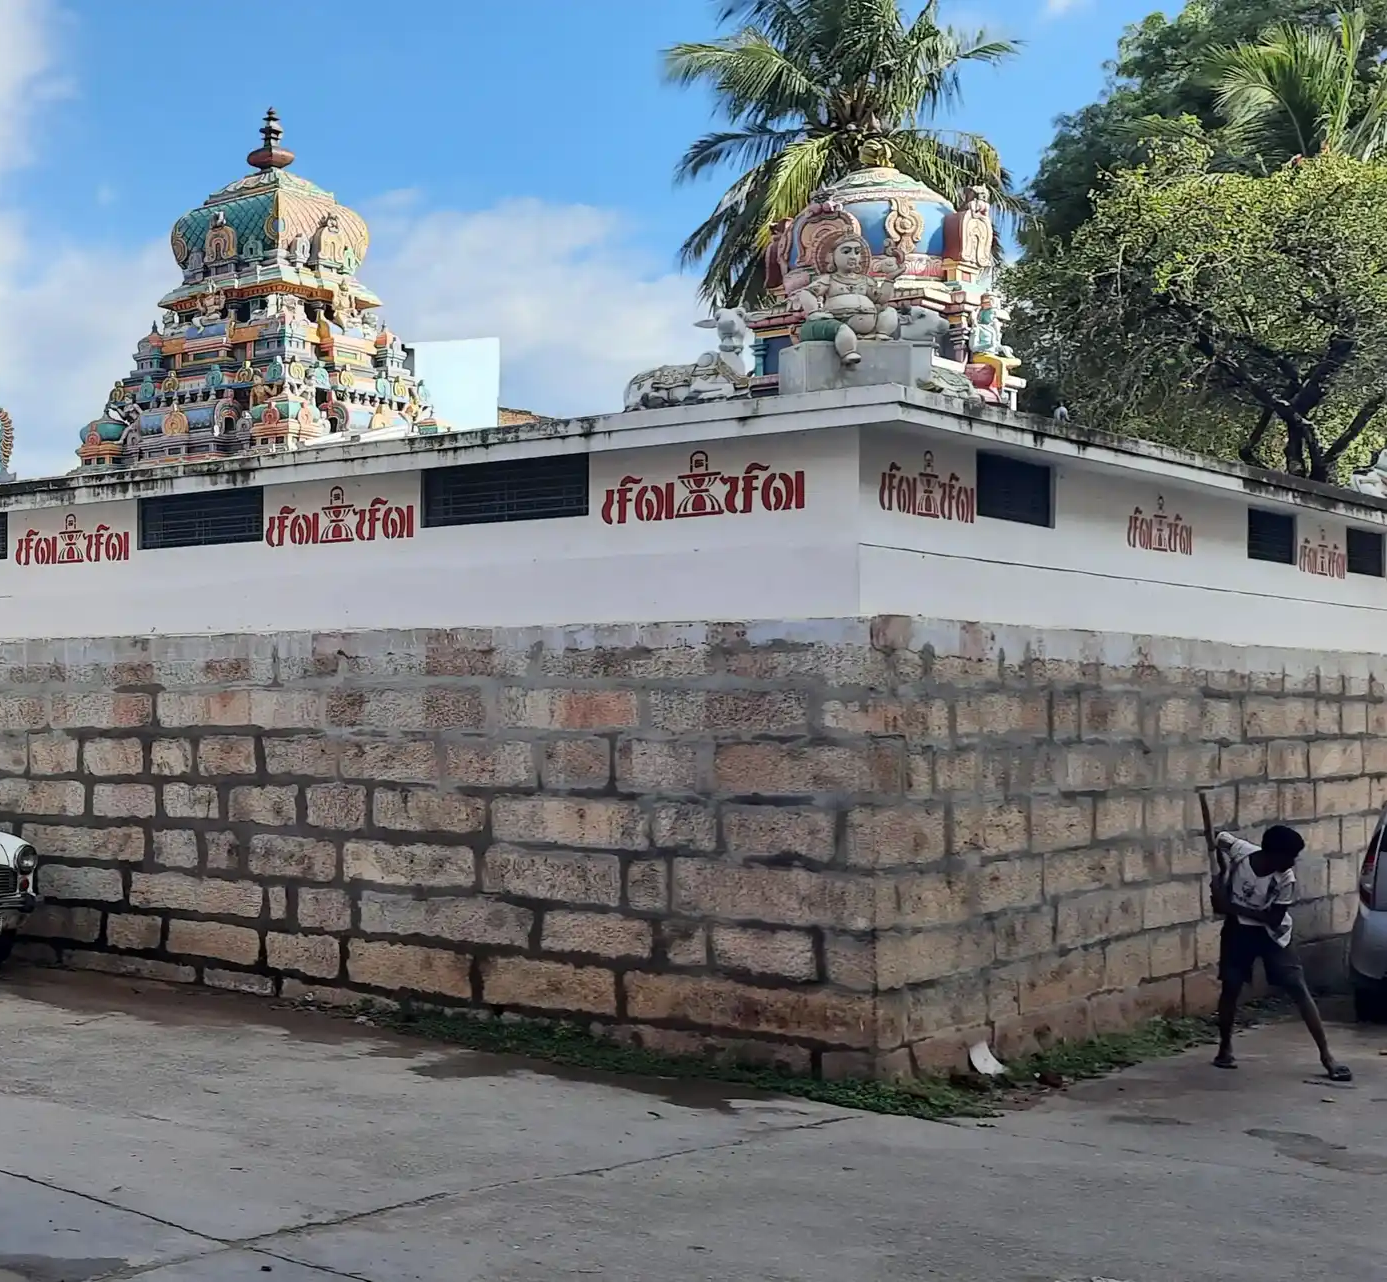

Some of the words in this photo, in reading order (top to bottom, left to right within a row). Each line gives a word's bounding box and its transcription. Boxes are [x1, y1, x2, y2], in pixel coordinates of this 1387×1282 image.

[601, 475, 675, 525] சிவ
[719, 462, 805, 514] சிவ
[879, 461, 917, 516] சிவ
[938, 472, 975, 523] சிவ
[15, 529, 57, 566] சிவ
[83, 523, 129, 563] சிவ
[265, 505, 319, 548] சிவ
[353, 497, 414, 542] சிவ
